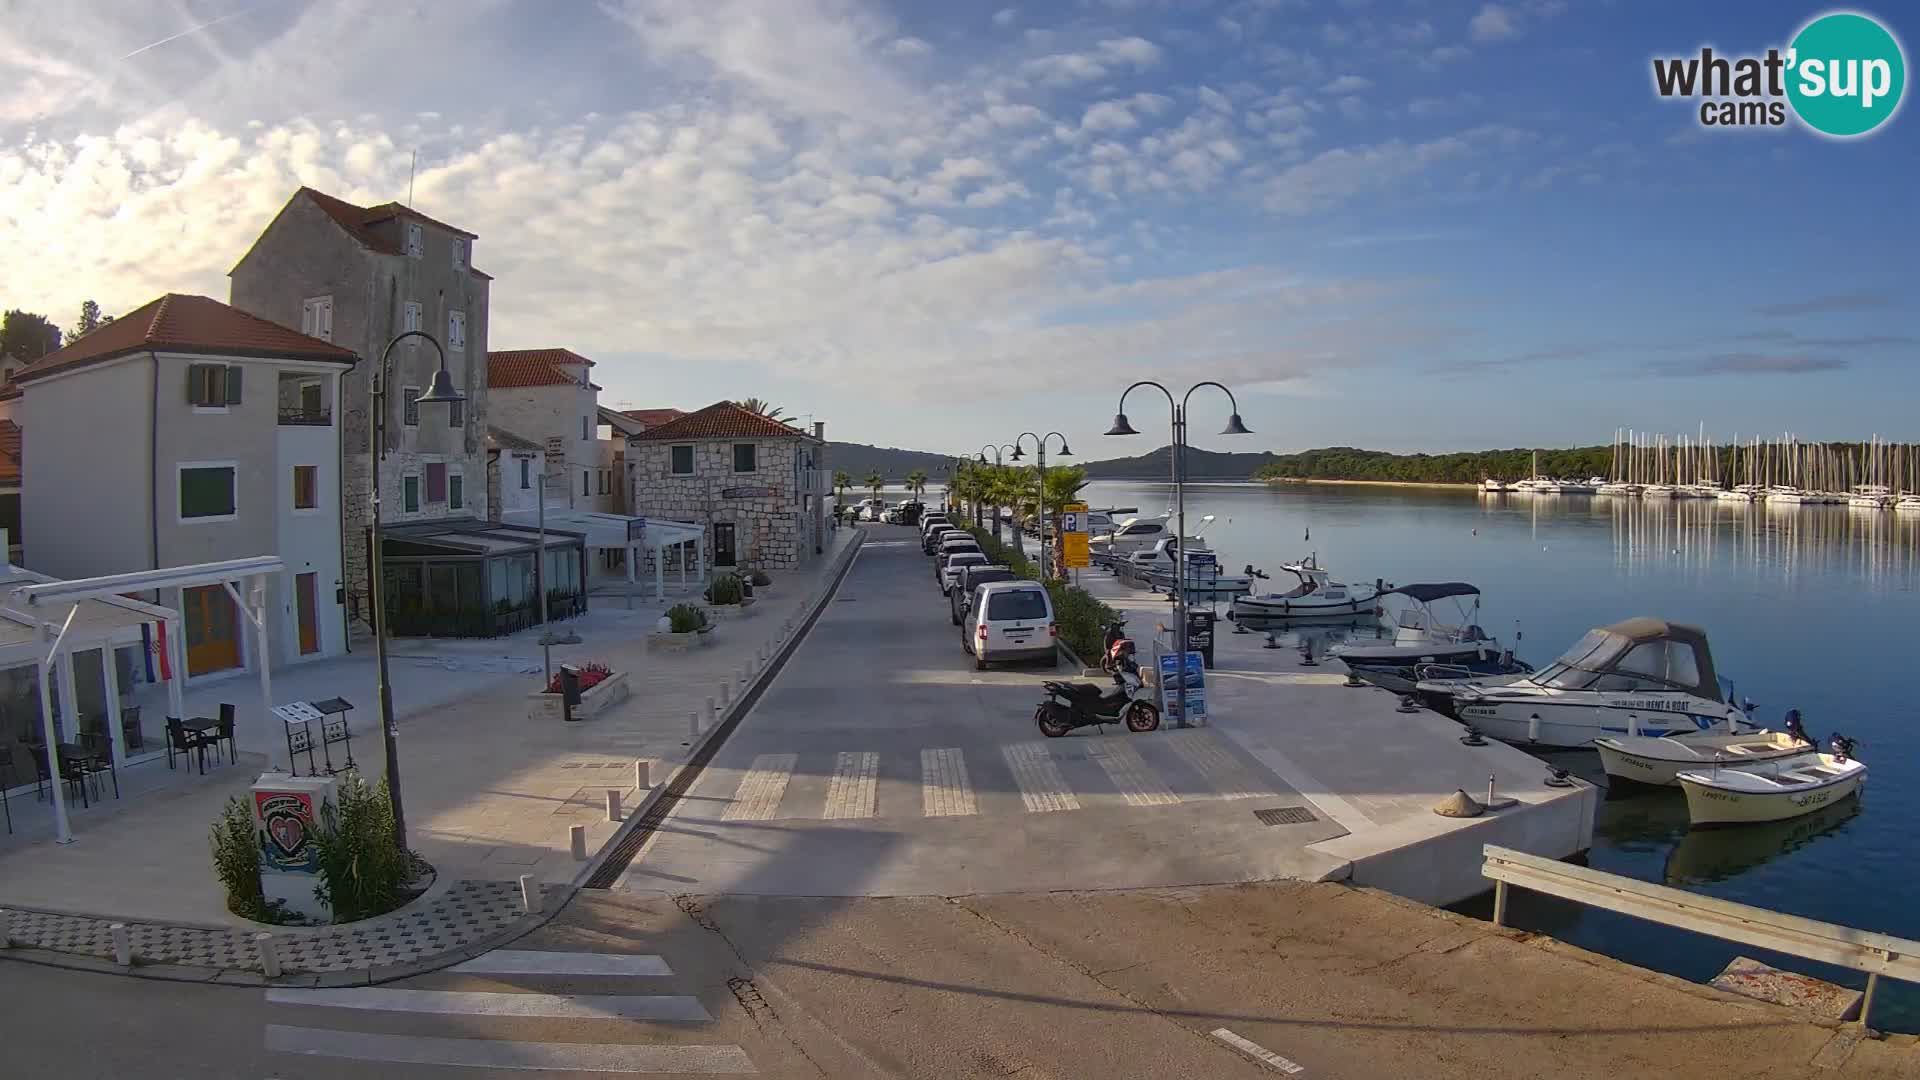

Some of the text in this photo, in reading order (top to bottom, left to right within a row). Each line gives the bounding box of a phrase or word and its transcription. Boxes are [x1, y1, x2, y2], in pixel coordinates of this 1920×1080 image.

[1065, 515, 1075, 530] P
[1646, 700, 1664, 711] RENT
[1671, 701, 1690, 712] BOAT
